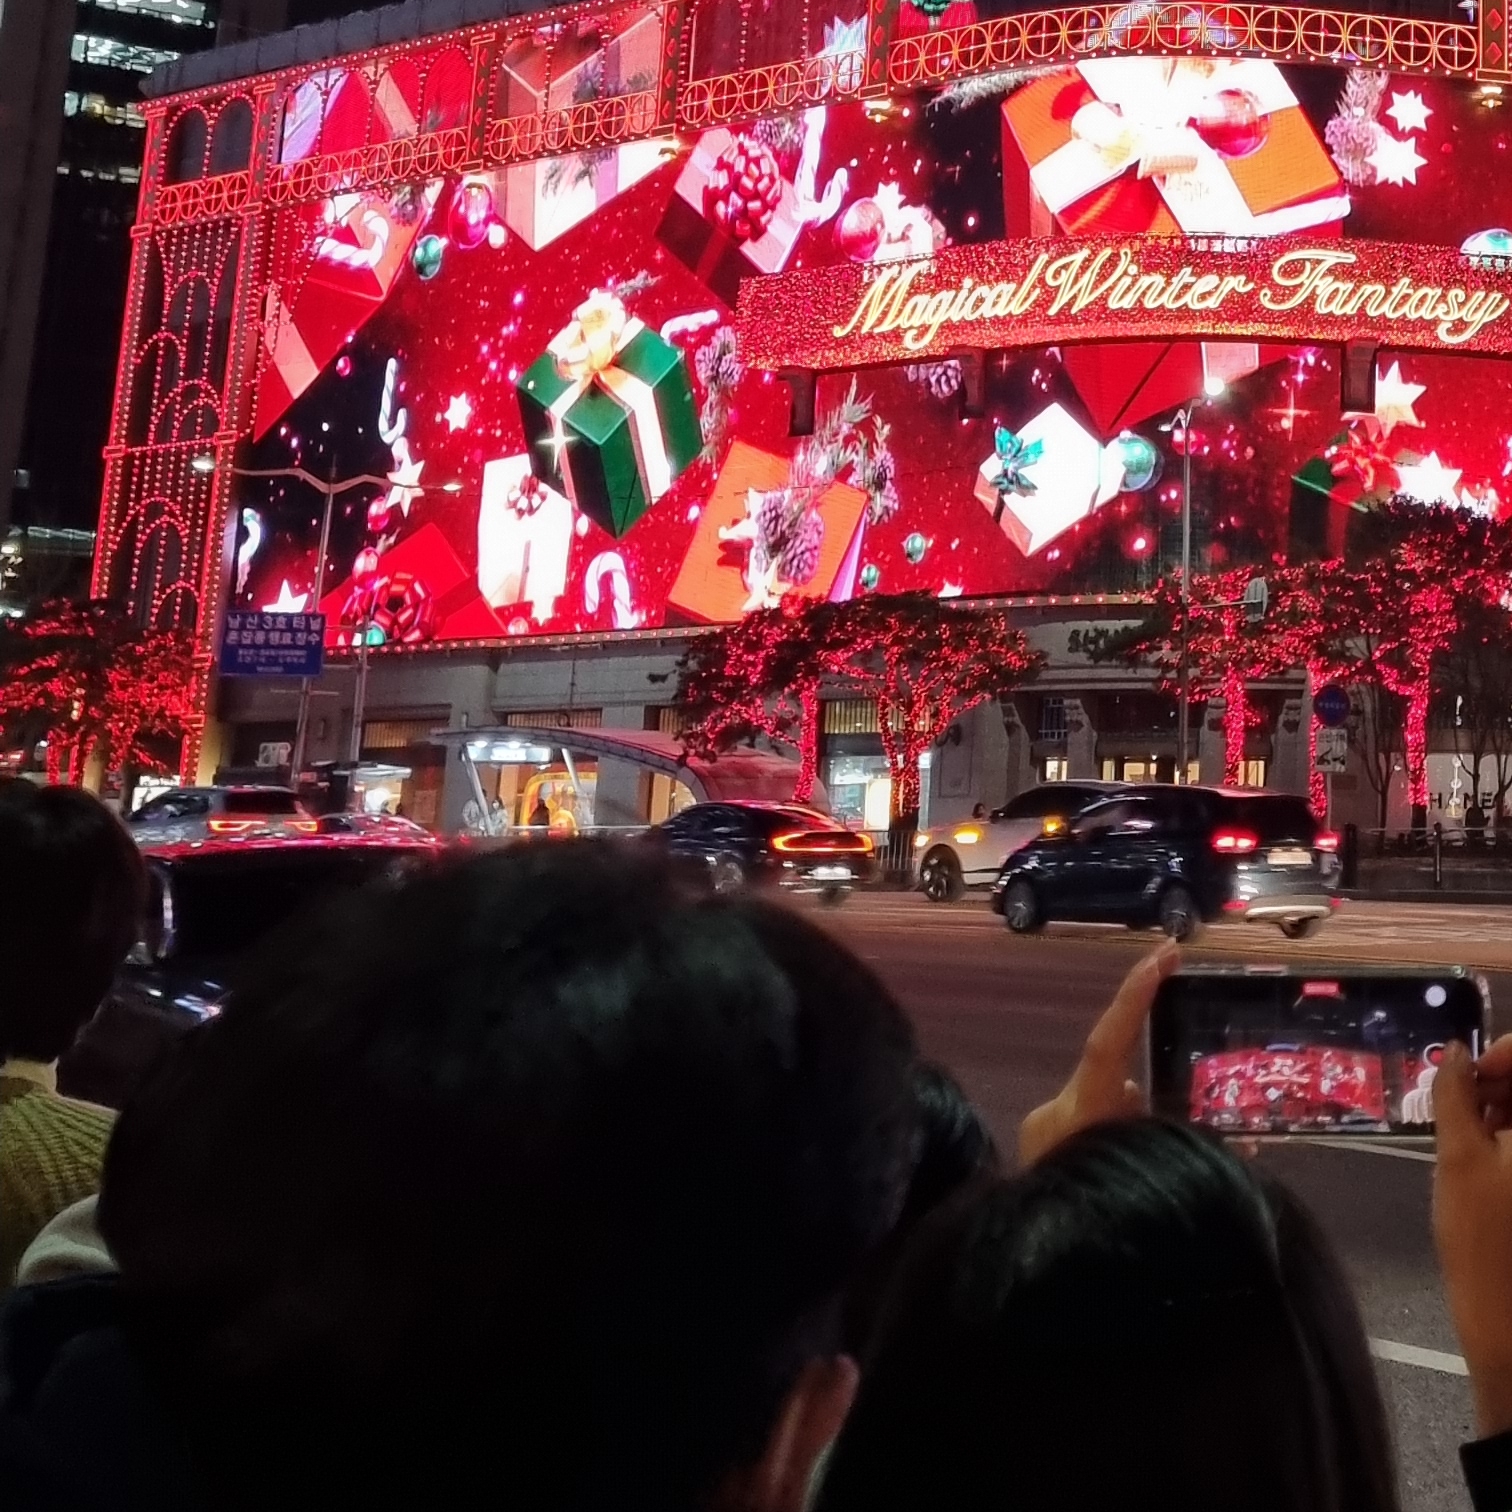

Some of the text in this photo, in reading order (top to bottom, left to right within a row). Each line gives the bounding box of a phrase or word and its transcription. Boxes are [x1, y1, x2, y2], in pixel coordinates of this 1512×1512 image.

[834, 248, 1510, 350] Magical Winter Fantasy
